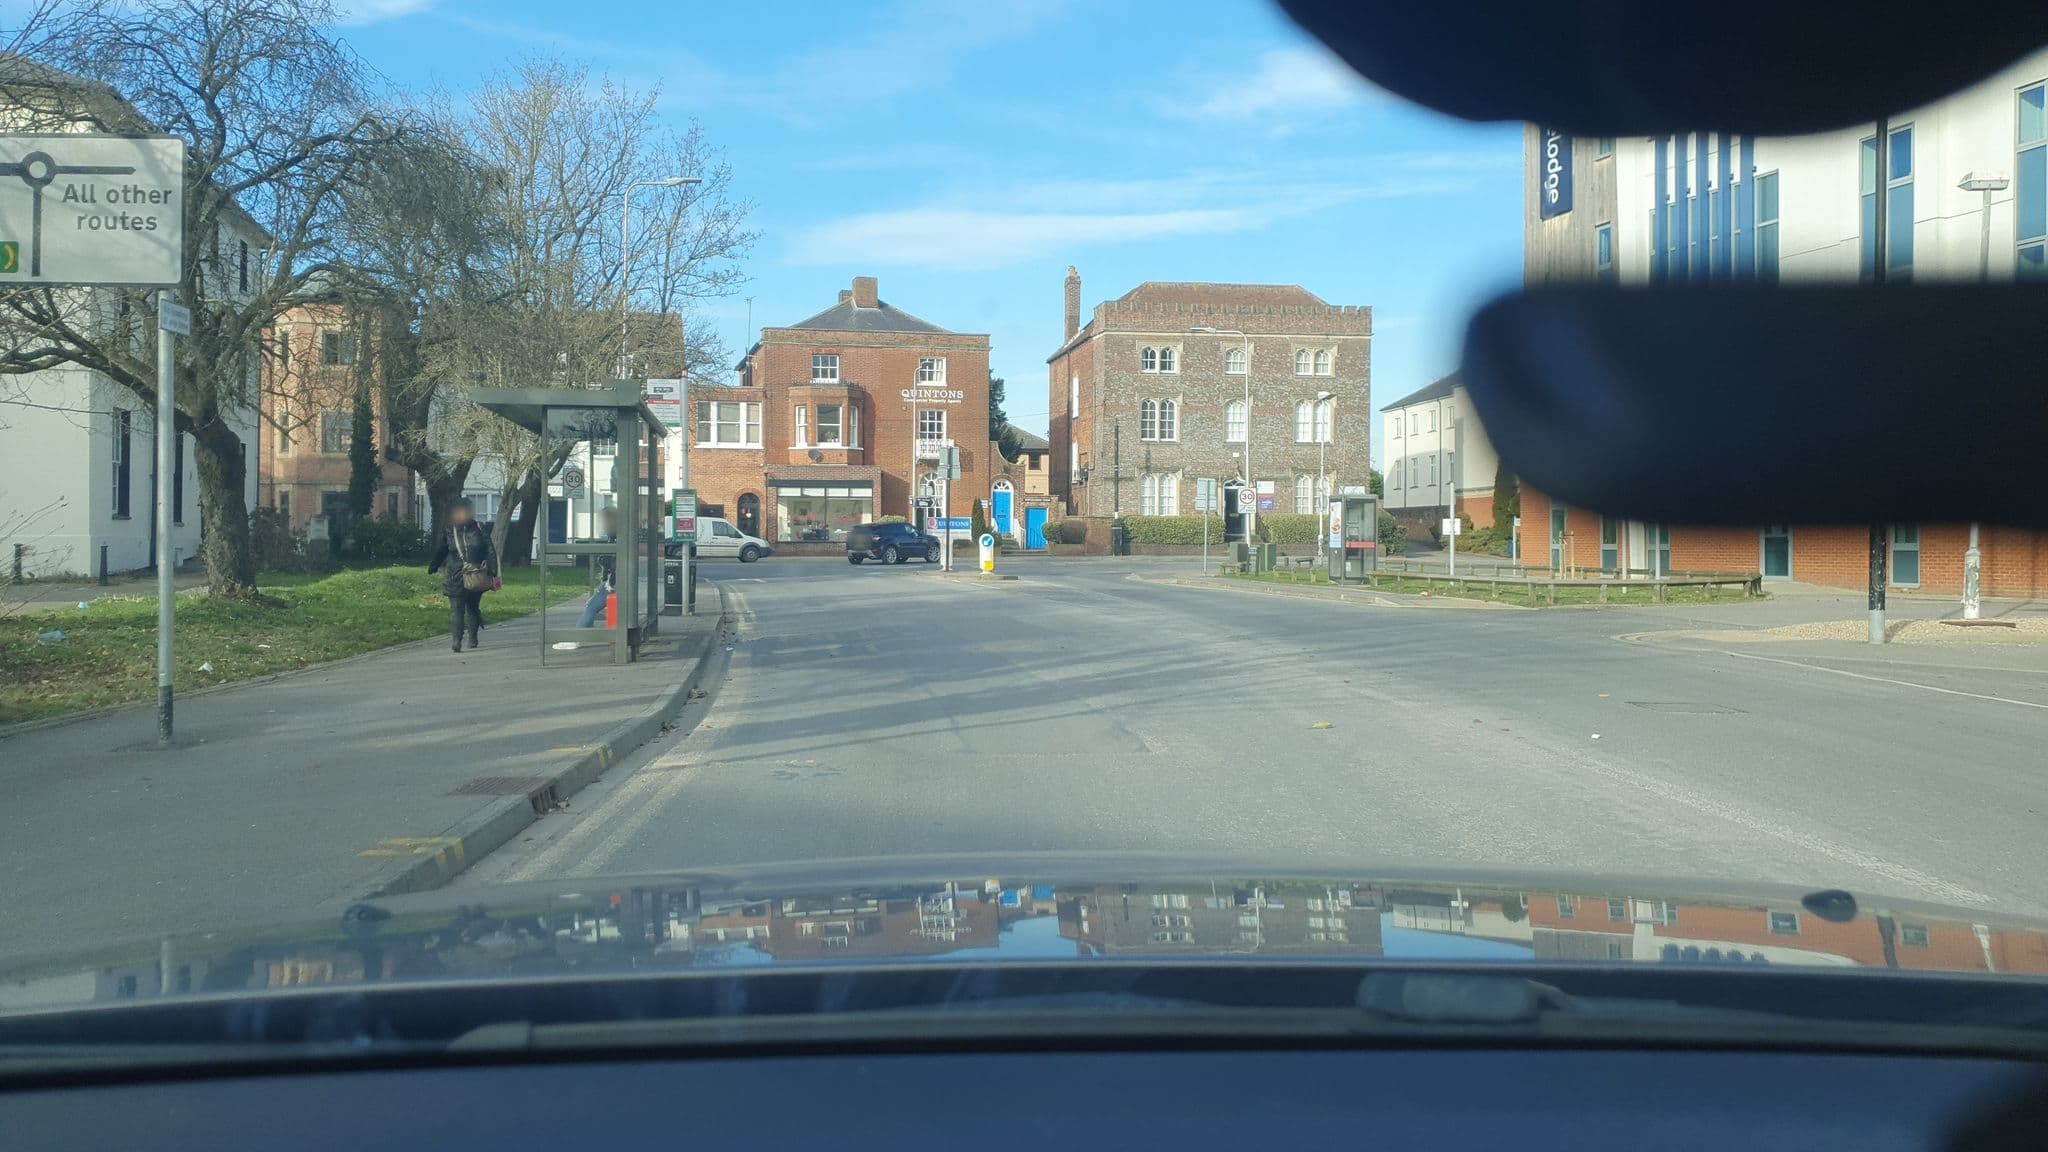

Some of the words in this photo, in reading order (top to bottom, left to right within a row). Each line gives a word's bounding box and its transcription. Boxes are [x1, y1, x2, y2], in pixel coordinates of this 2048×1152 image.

[62, 183, 97, 203] All
[106, 184, 173, 205] other
[77, 211, 158, 231] routes
[901, 389, 964, 399] QUINTONS
[568, 475, 581, 483] 30
